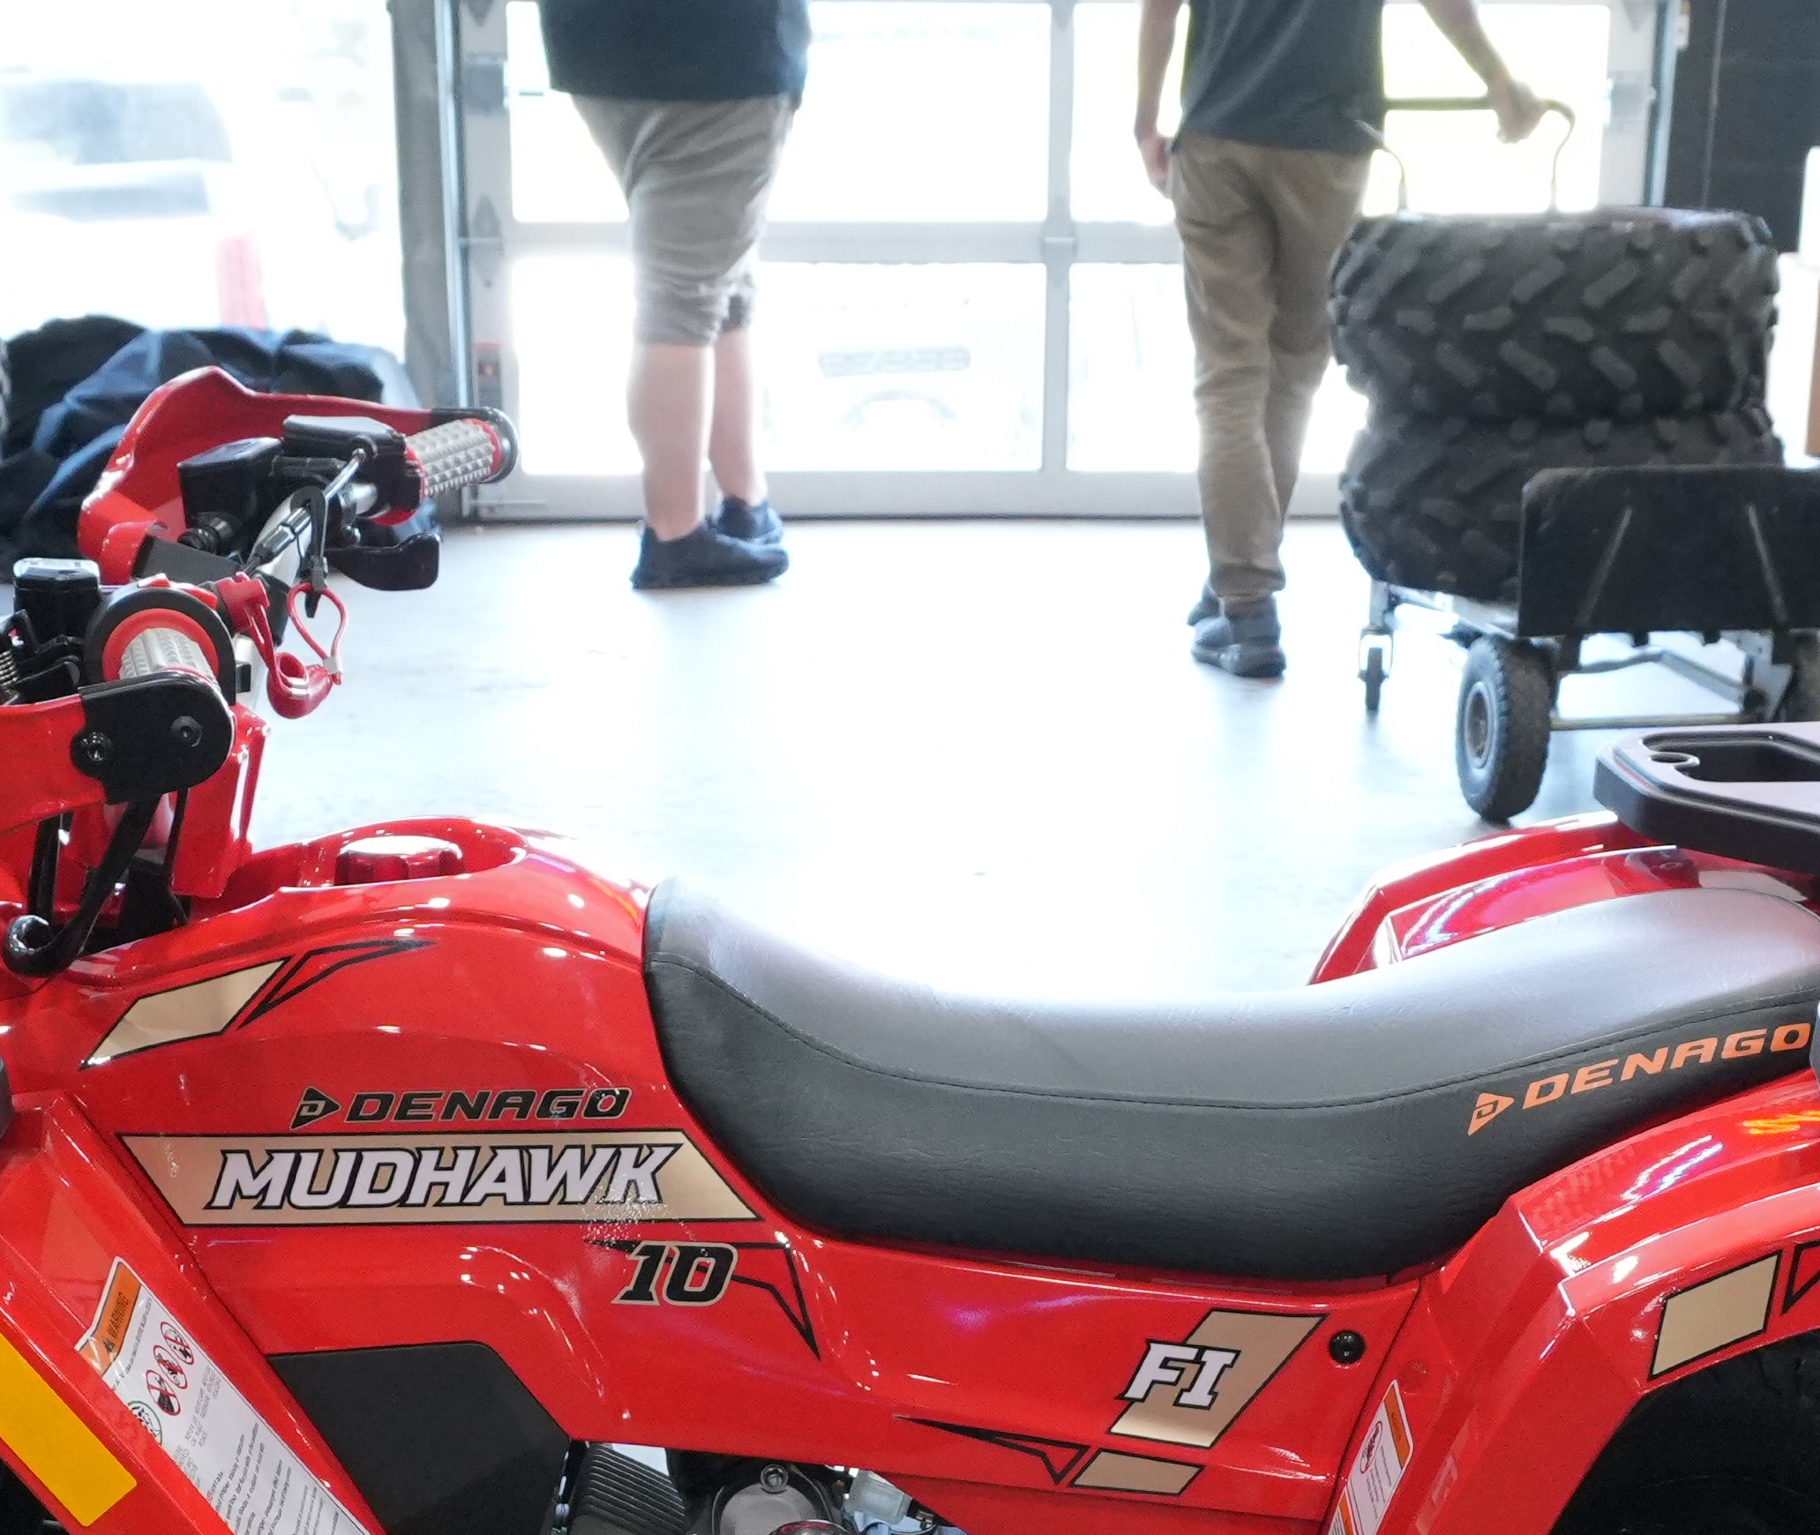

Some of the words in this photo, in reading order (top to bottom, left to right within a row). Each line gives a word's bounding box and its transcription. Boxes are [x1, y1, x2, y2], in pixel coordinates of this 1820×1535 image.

[1522, 1022, 1812, 1110] DENAGO
[344, 1088, 633, 1122] DENAGO
[204, 1143, 684, 1211] MUDHAWK
[611, 1241, 738, 1306] 10
[107, 1291, 130, 1340] WARNING
[1116, 1339, 1241, 1410] FI
